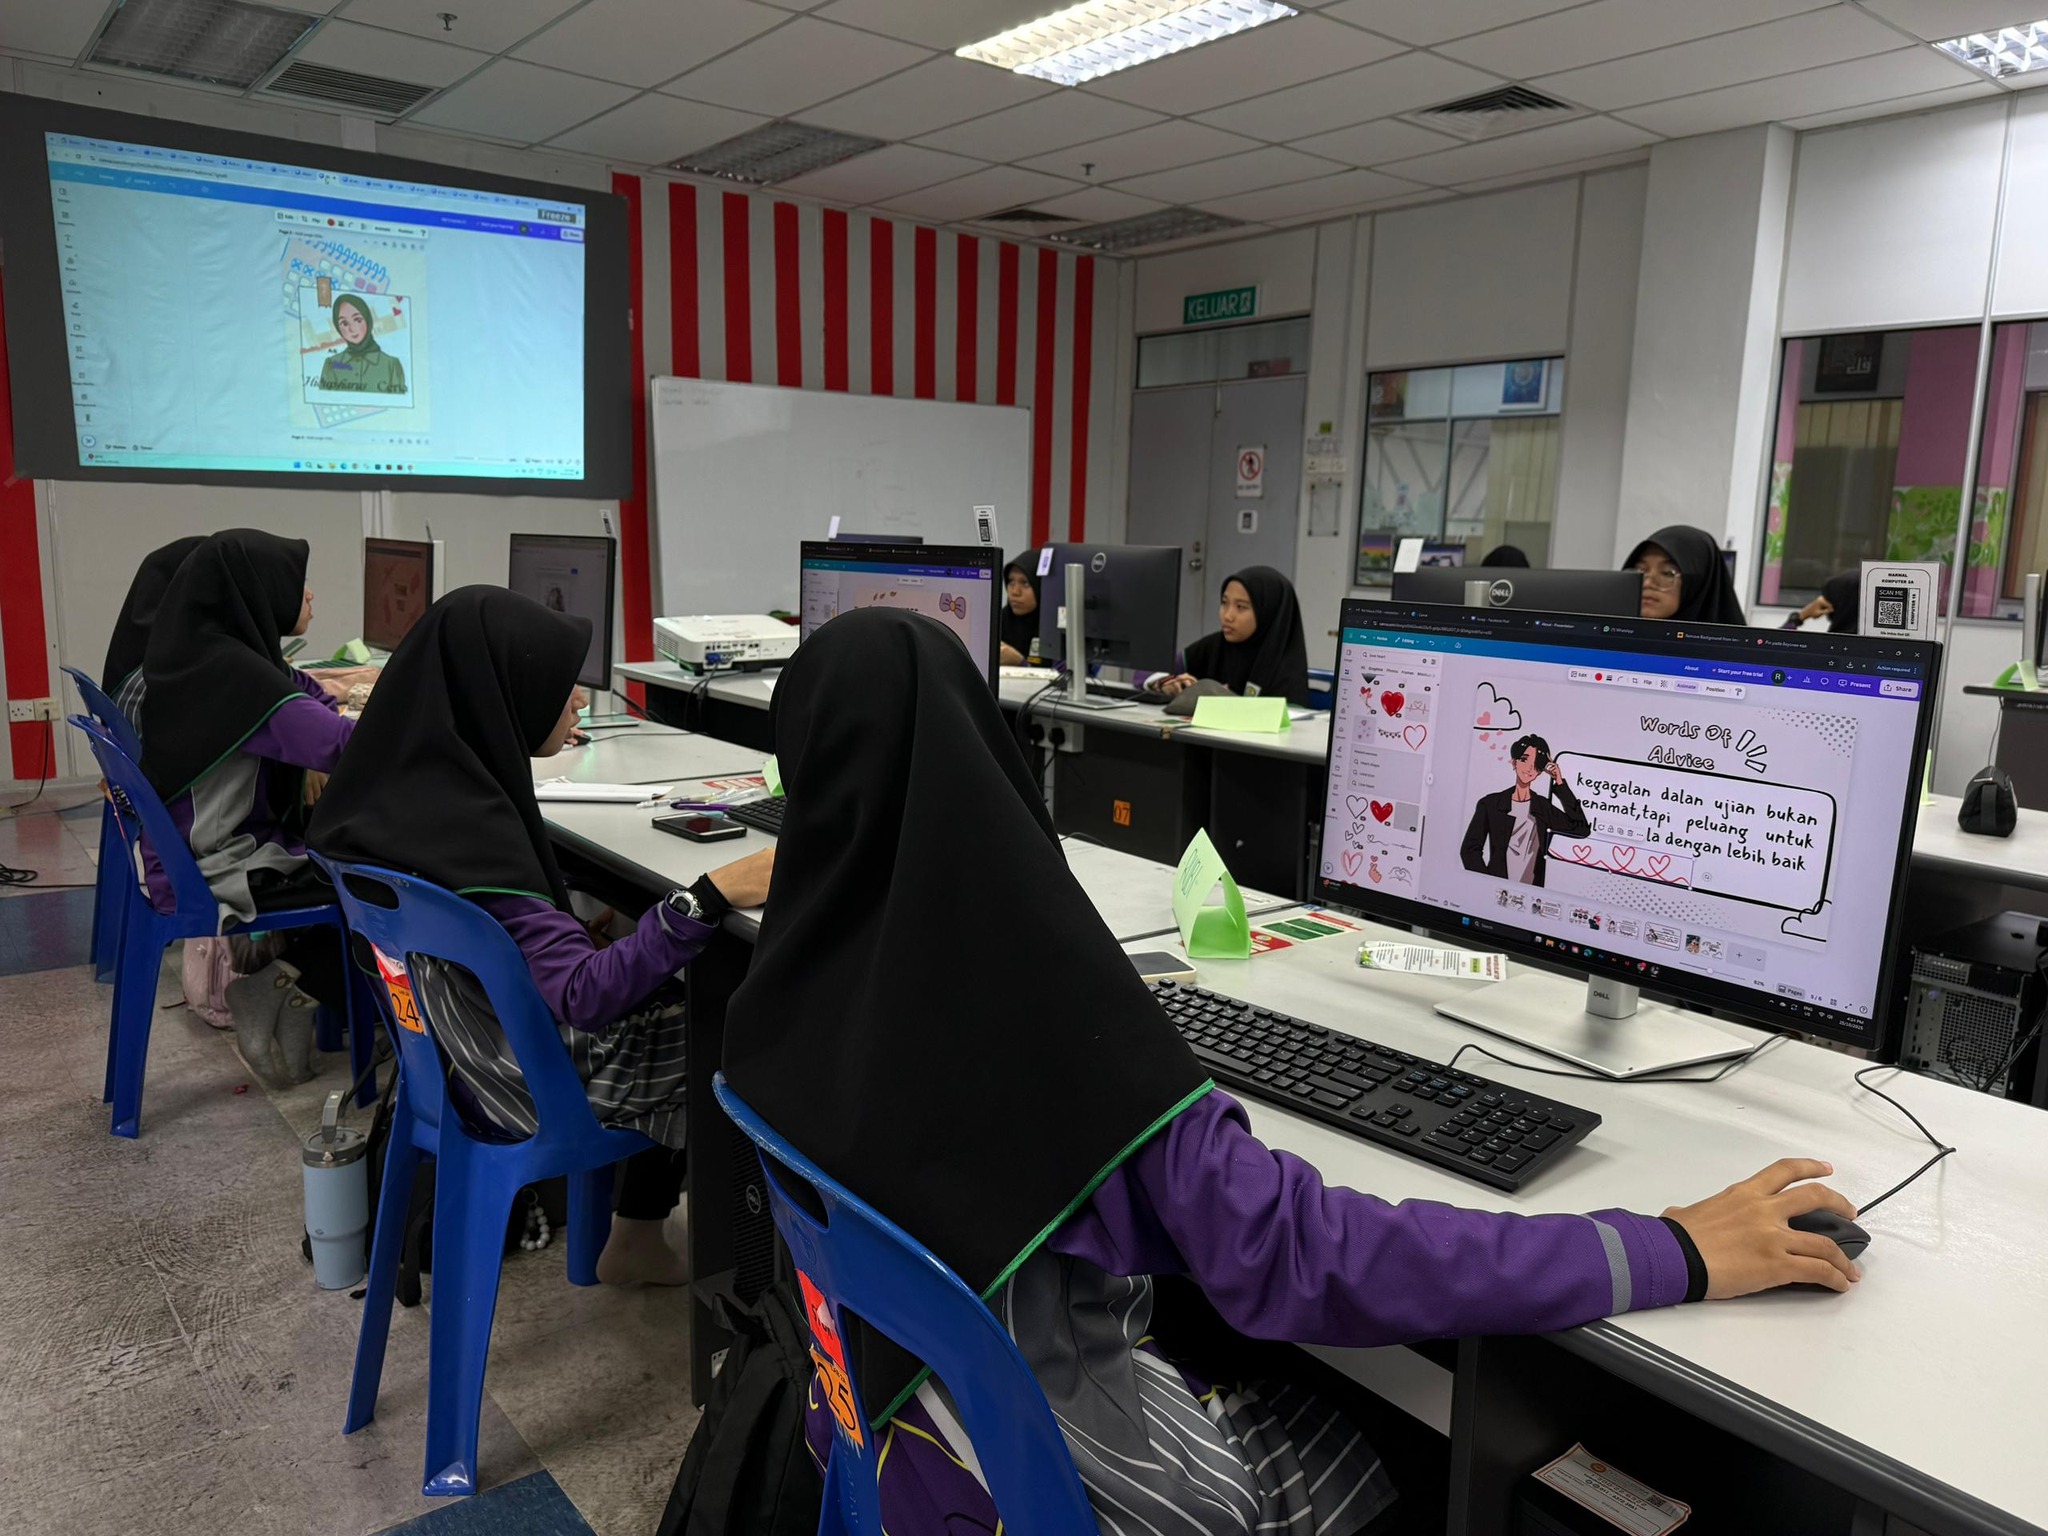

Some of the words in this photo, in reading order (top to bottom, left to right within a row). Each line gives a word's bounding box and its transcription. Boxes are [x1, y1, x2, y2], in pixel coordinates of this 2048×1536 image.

[541, 211, 572, 223] Freeze
[1187, 293, 1239, 322] KELUAR
[1718, 667, 1731, 675] Start
[1731, 669, 1742, 677] your
[1850, 681, 1872, 689] Present
[1895, 685, 1913, 693] Share
[1640, 716, 1701, 739] Words
[1705, 725, 1732, 748] Of
[1648, 745, 1715, 770] Advice
[1577, 772, 1651, 798] kegagalan
[1661, 787, 1704, 806] dalan
[1715, 799, 1755, 819] ujian
[1766, 805, 1817, 826] bukan
[1114, 804, 1129, 823] 07
[1686, 817, 1748, 844] peluang
[1766, 832, 1815, 849] untuk
[1665, 833, 1722, 858] dengan
[1727, 843, 1766, 866] lebih
[1772, 852, 1806, 871] baik
[1594, 990, 1610, 1001] DELL
[1787, 988, 1803, 997] Pages
[392, 993, 419, 1028] 24
[817, 1362, 856, 1431] 25
